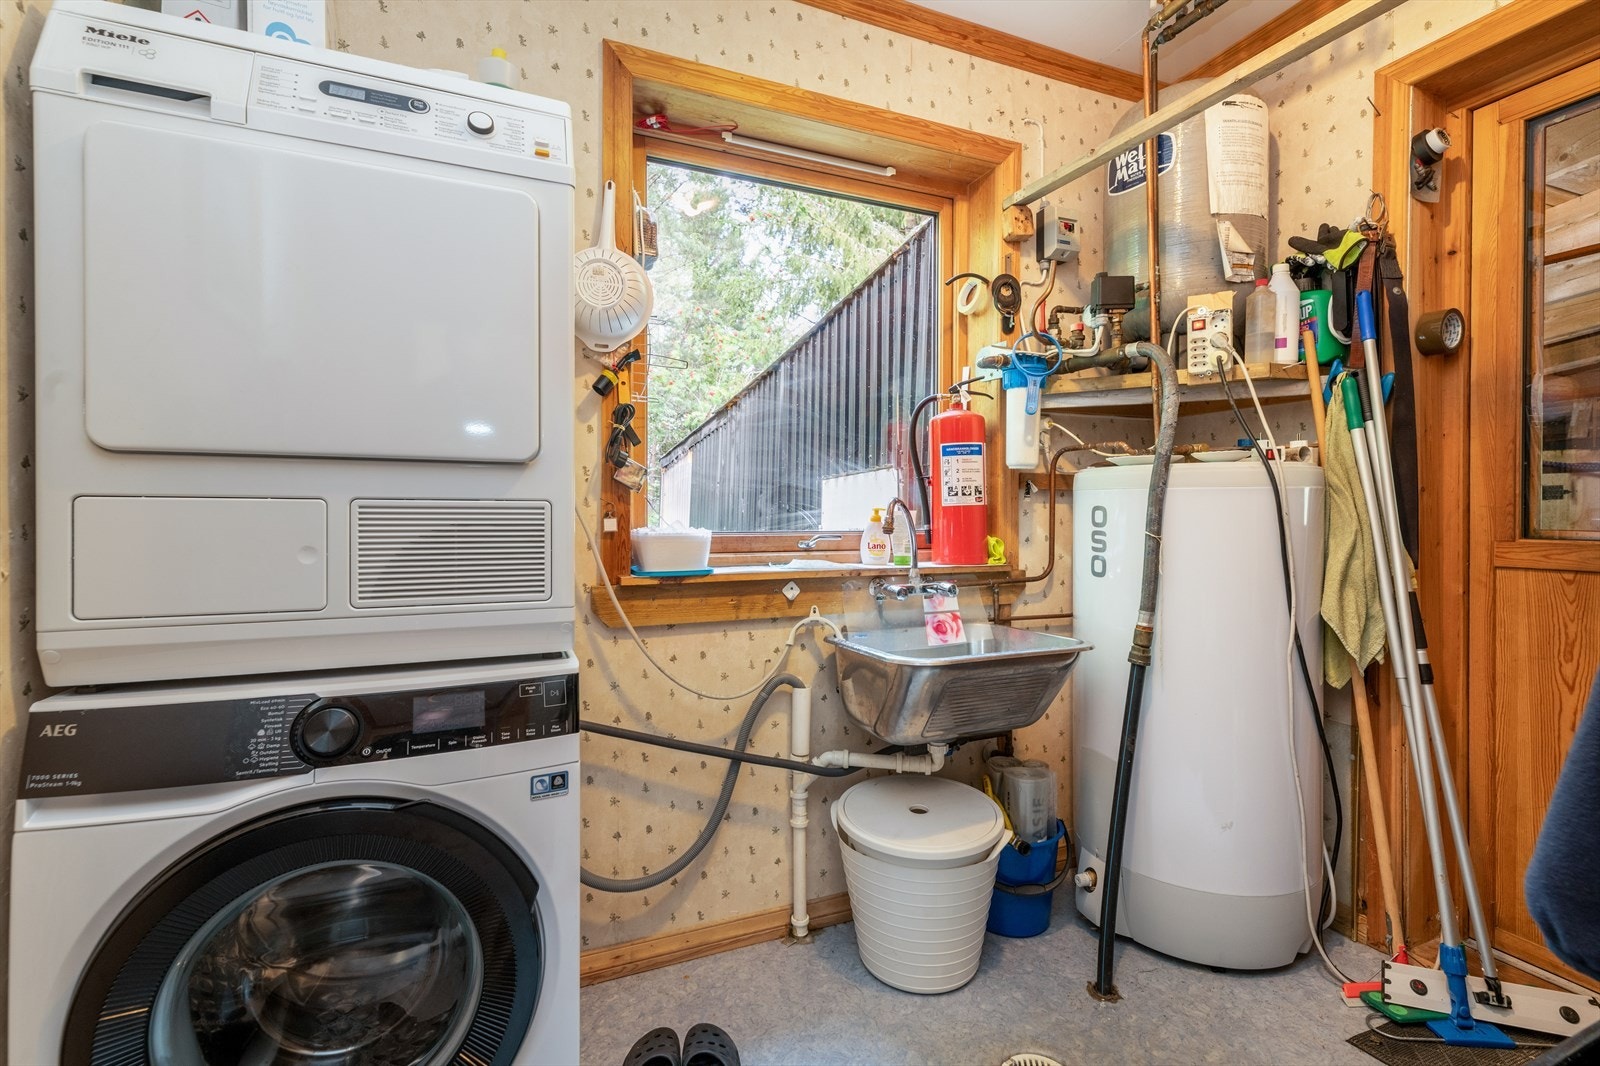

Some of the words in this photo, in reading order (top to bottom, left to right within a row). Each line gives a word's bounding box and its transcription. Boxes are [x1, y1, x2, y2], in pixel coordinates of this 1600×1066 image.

[82, 36, 117, 47] EDITION
[85, 26, 151, 46] Miele
[1115, 143, 1144, 167] Wel
[1115, 156, 1147, 182] Mat
[1090, 505, 1108, 578] OSO
[39, 723, 78, 738] AEG
[411, 742, 436, 750] Temperature
[52, 772, 79, 780] SERIES
[29, 781, 64, 789] ProSteam
